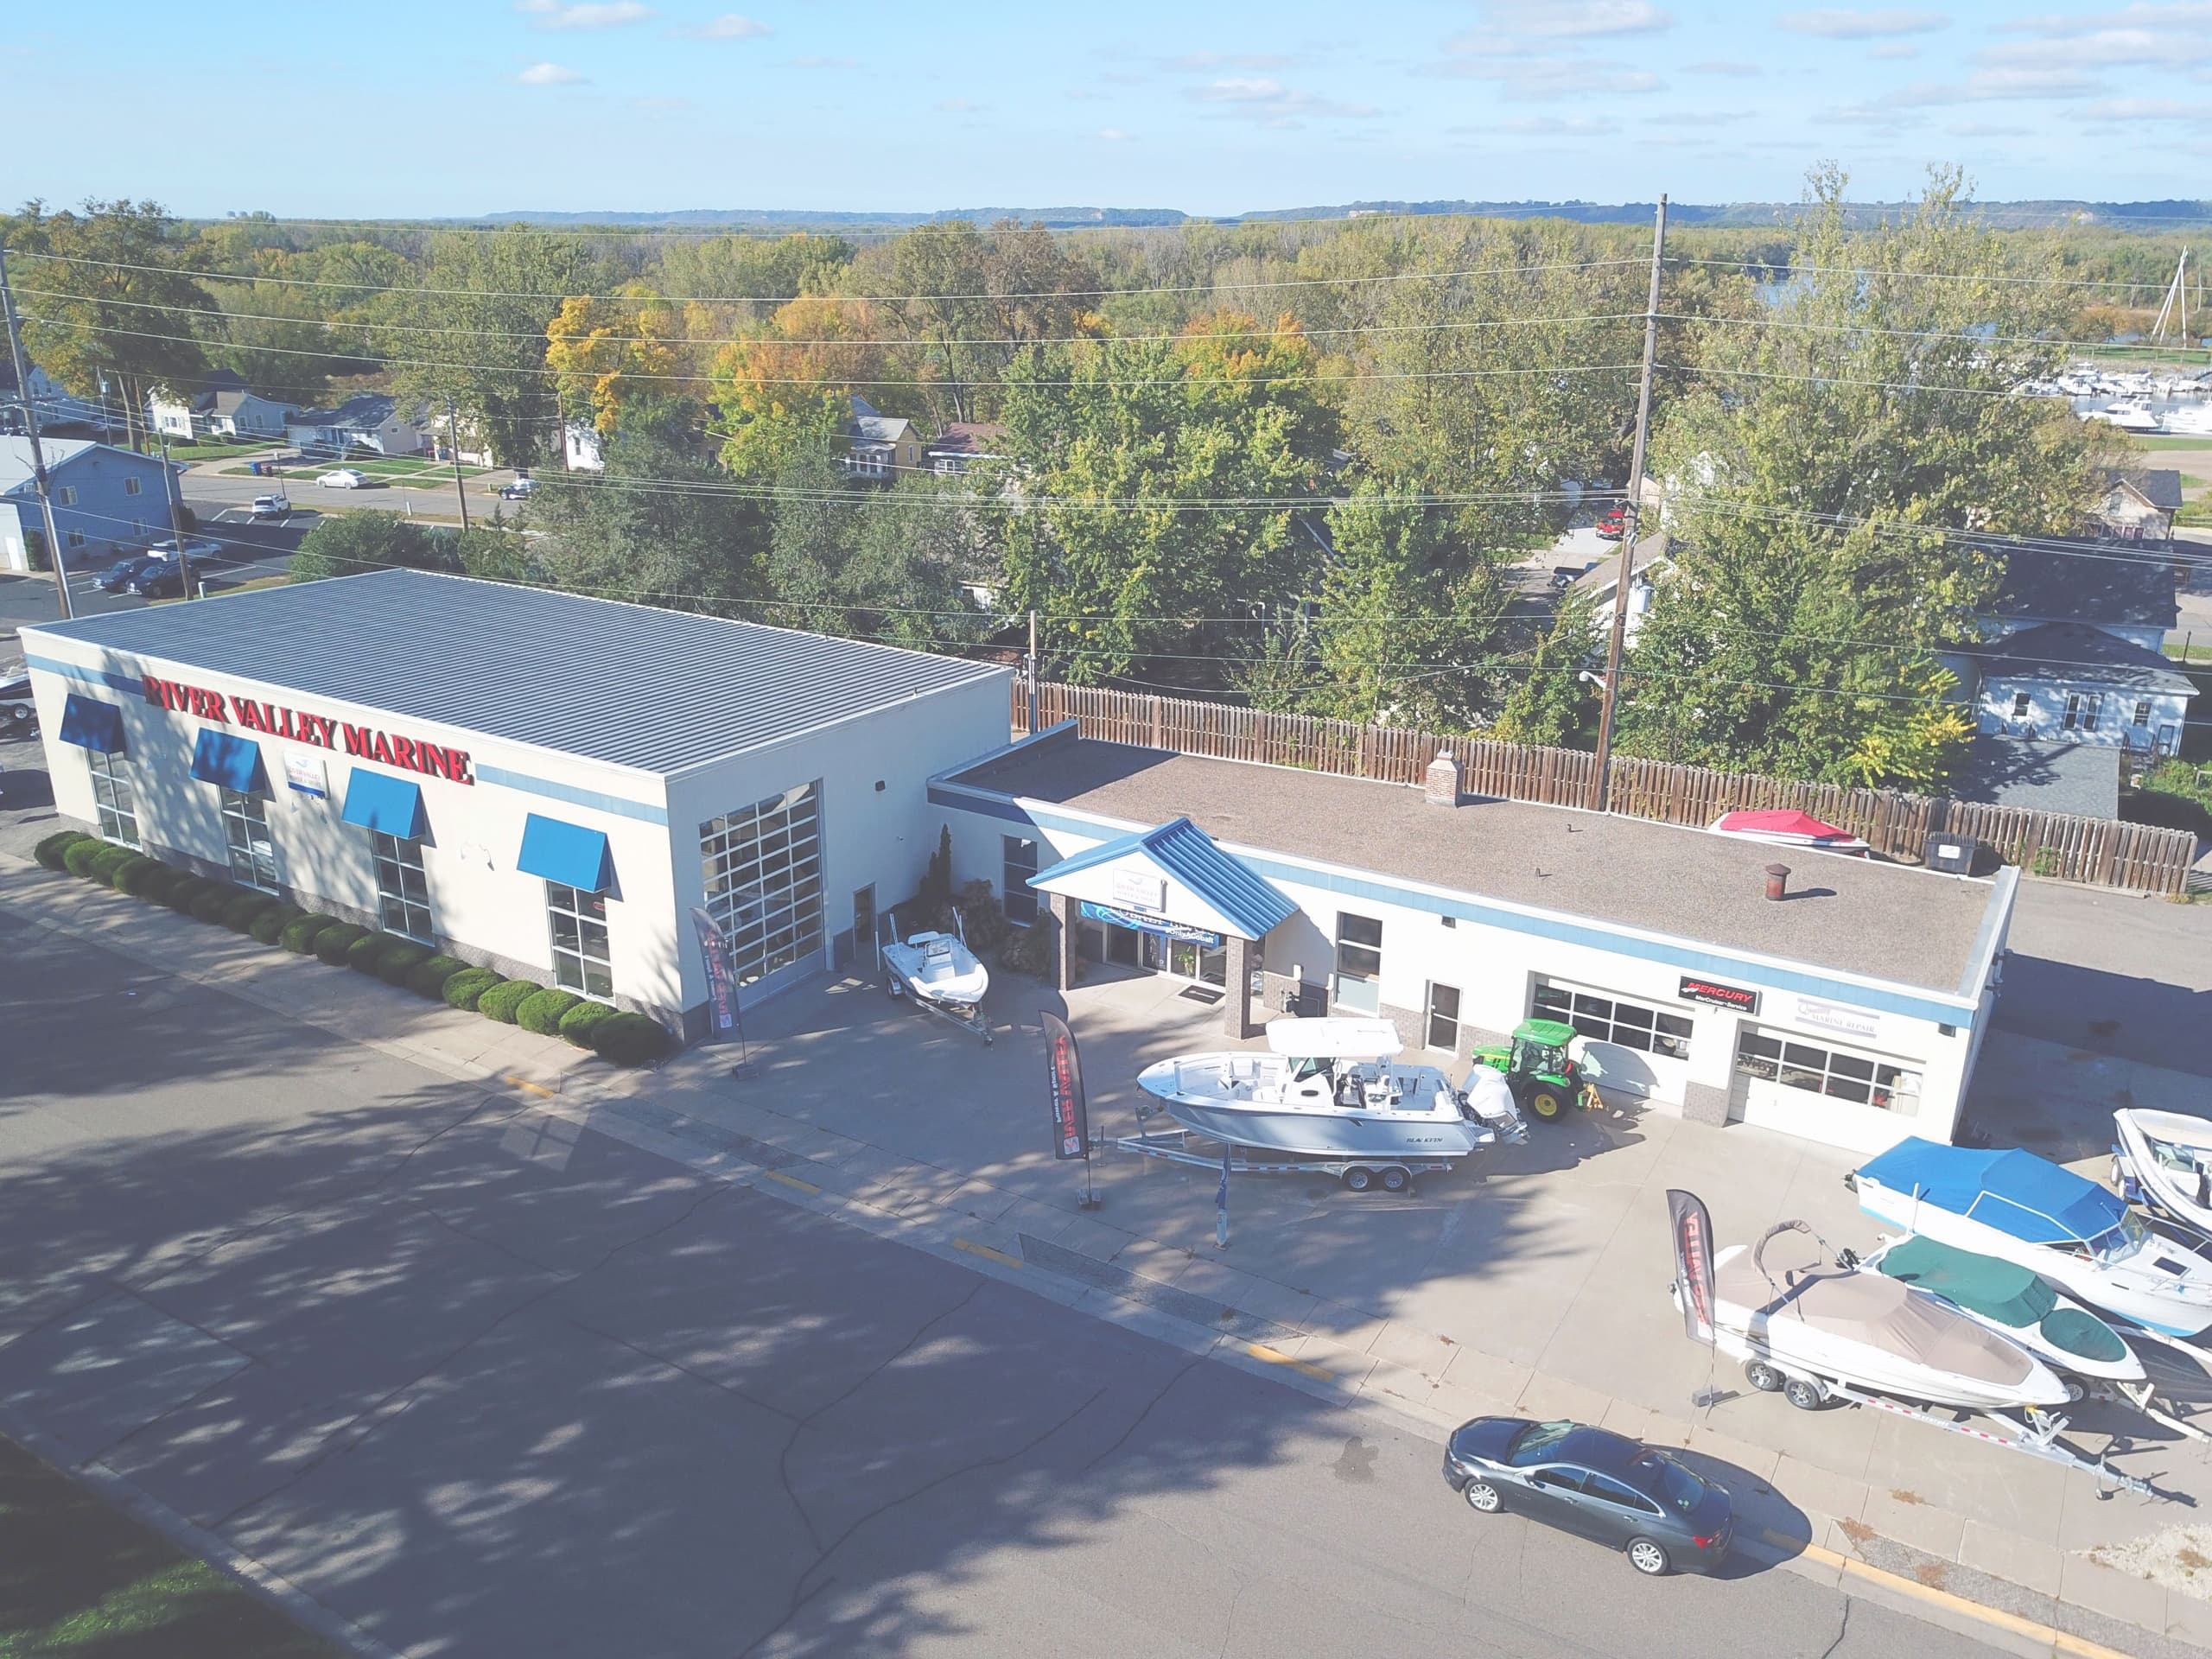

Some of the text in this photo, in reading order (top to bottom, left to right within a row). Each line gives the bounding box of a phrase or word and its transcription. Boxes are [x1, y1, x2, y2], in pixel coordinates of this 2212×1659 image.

[142, 674, 474, 786] RIVER VALLEY MARINE
[1688, 982, 1753, 1002] MERCURY
[1812, 1014, 1875, 1033] MARINE REPAIR
